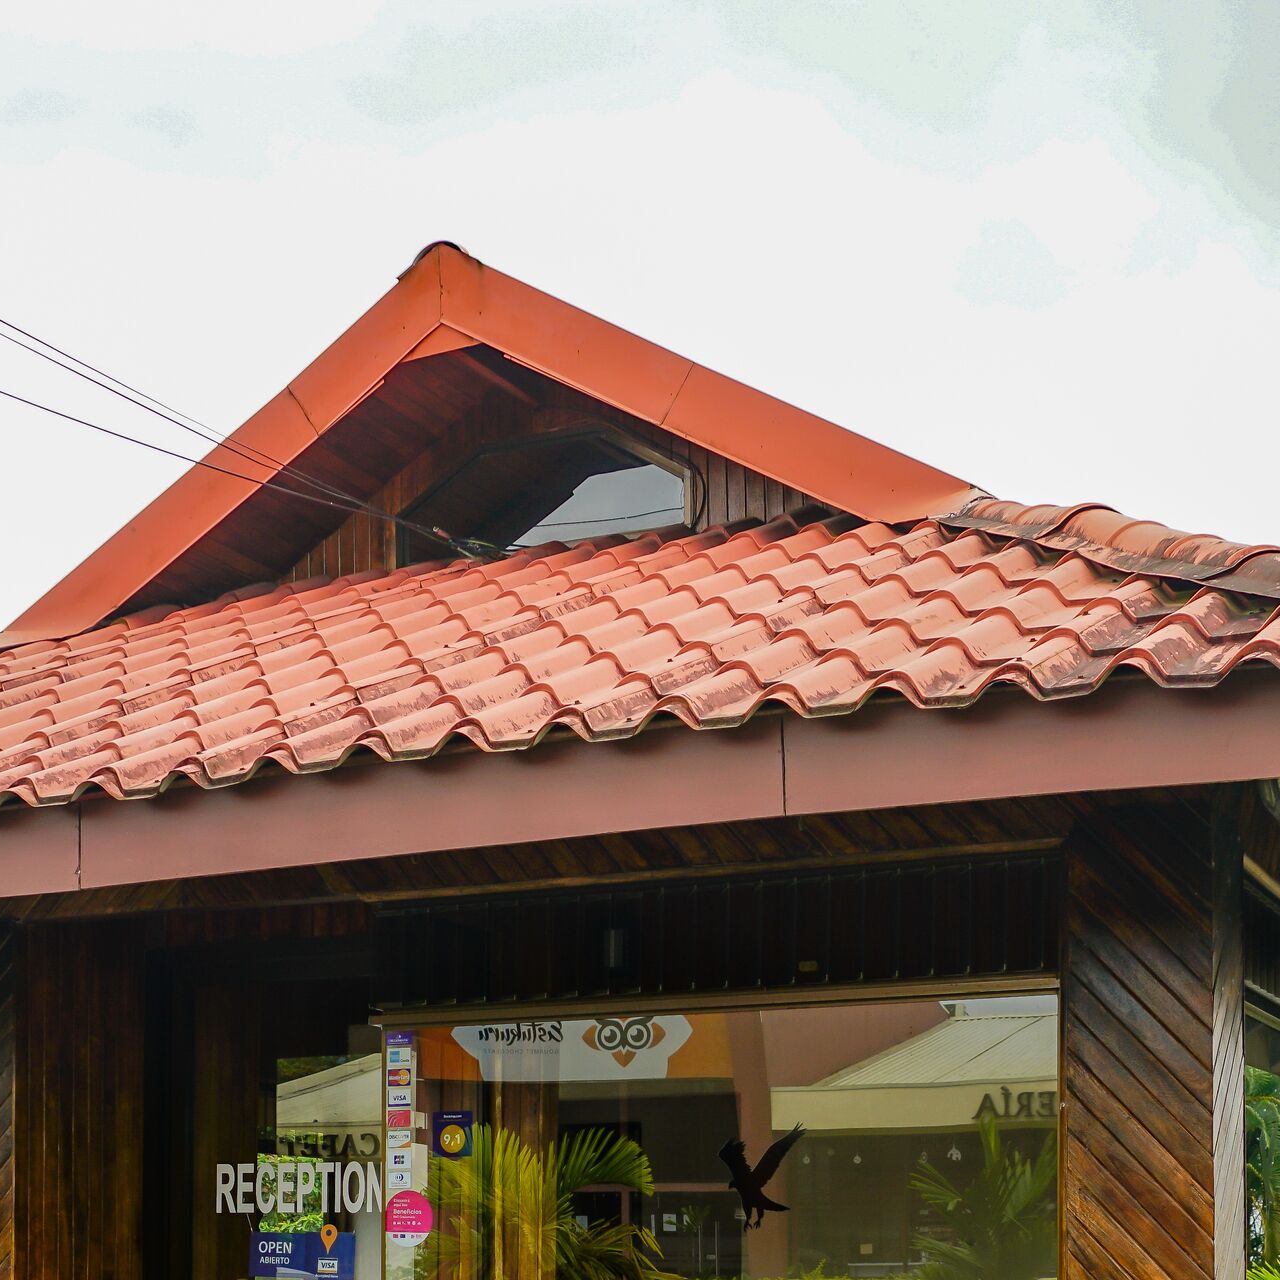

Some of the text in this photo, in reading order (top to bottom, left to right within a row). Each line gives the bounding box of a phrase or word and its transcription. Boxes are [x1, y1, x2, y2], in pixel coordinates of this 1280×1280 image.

[443, 1133, 461, 1146] 9,1
[215, 1161, 383, 1214] RECEPTION
[259, 1241, 292, 1254] OPEN
[259, 1256, 290, 1265] ABIERTO
